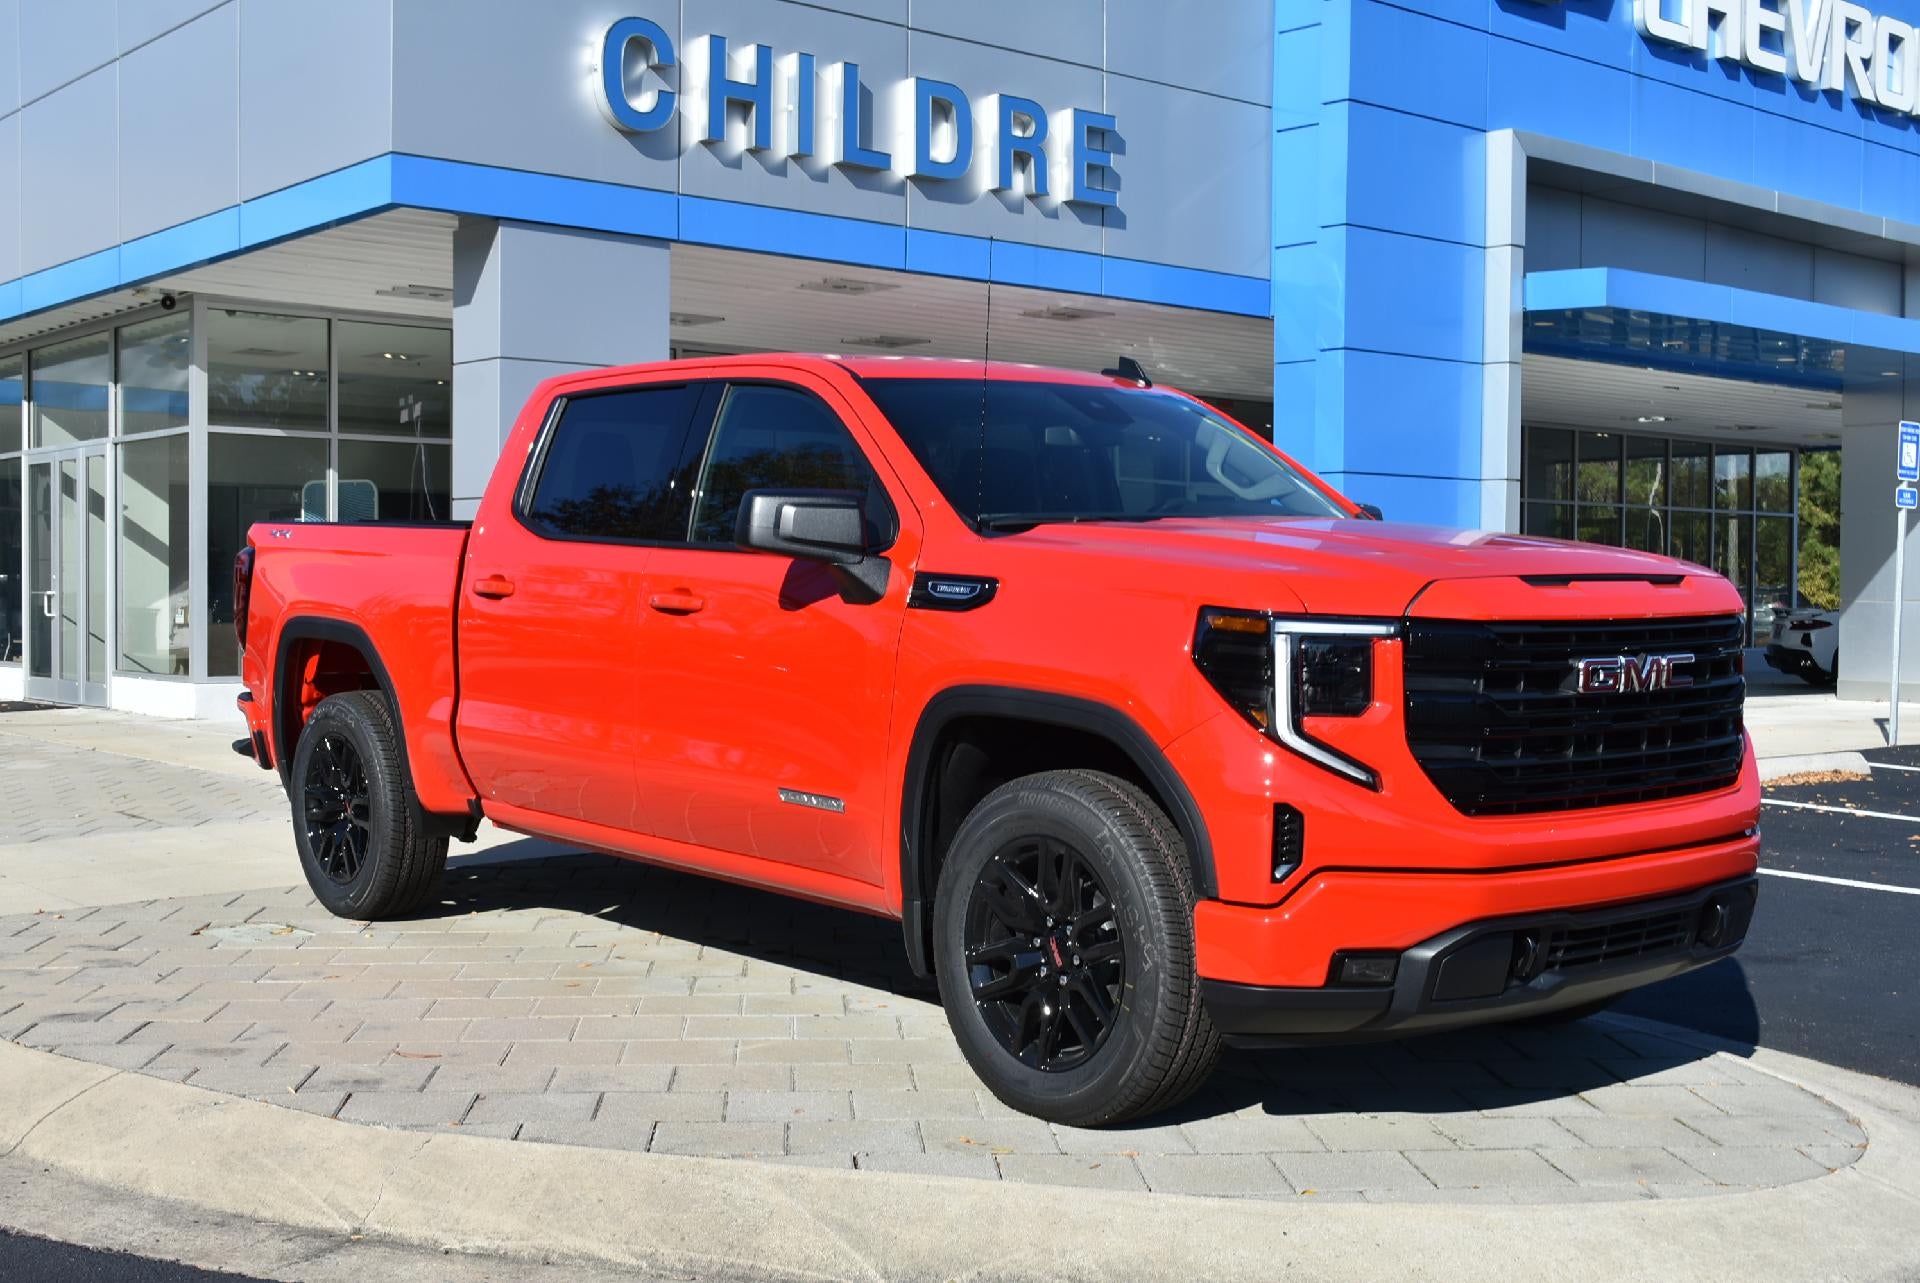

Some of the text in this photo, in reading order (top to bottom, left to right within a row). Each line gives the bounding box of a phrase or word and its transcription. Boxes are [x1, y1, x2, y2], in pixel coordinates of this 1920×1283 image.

[597, 16, 1119, 208] CHILDRE
[1635, 0, 1920, 115] HEVRO
[1578, 654, 1695, 693] GMC
